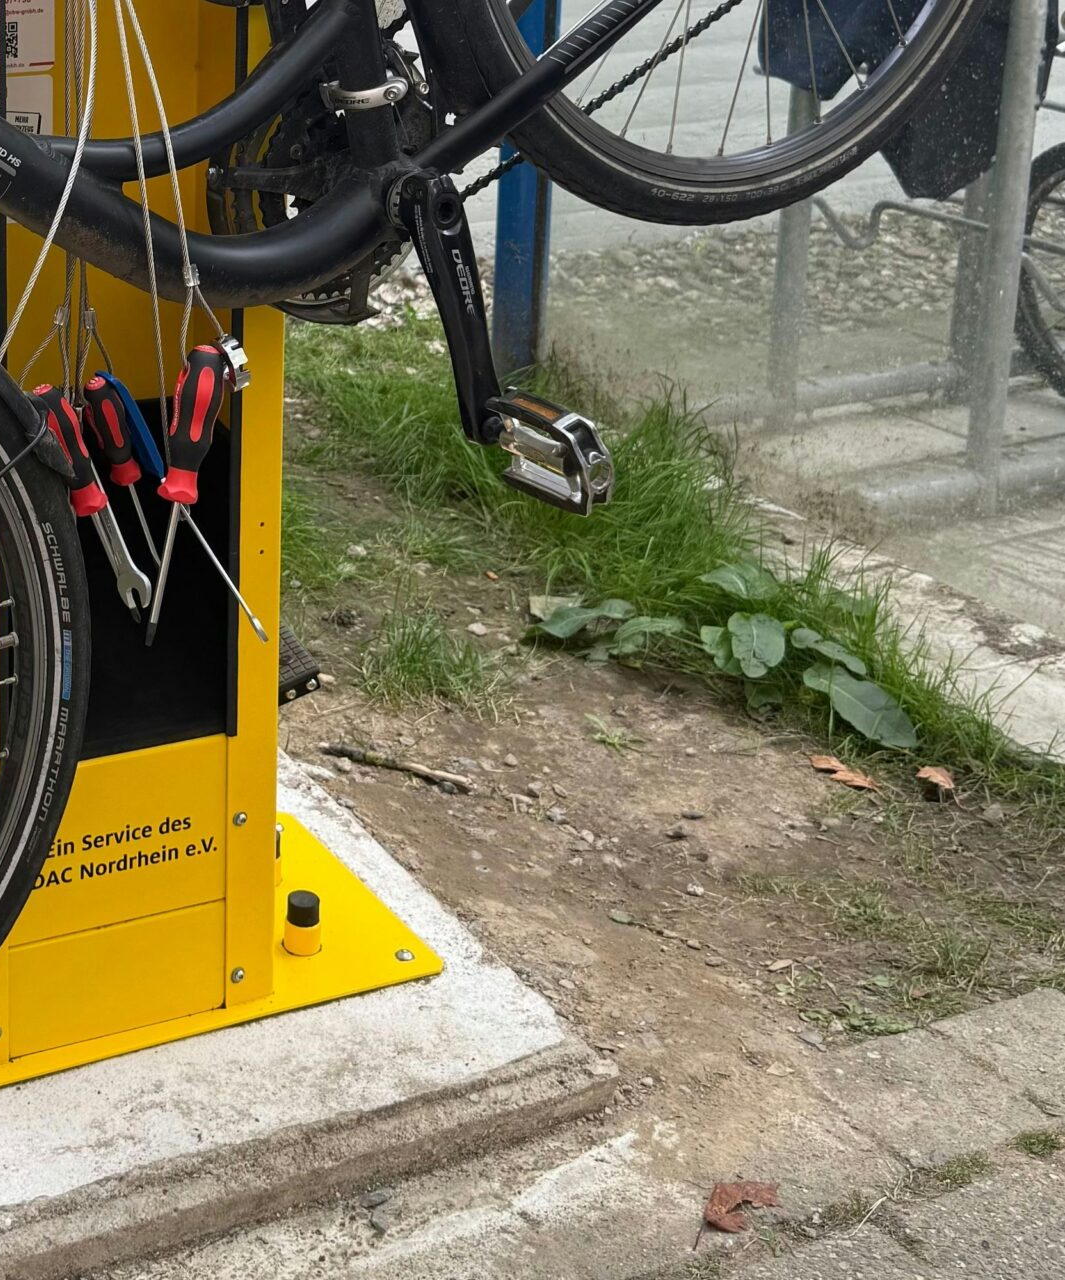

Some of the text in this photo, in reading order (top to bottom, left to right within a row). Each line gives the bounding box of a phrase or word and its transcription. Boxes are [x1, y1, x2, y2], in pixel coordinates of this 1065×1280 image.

[6, 154, 22, 168] HS
[451, 249, 476, 317] DEORE
[41, 521, 72, 623] SCHWALBE
[38, 706, 69, 822] MARATHON
[80, 845, 179, 880] Nordrhein
[185, 836, 218, 857] e.V.
[81, 824, 153, 852] Service
[158, 816, 192, 835] des
